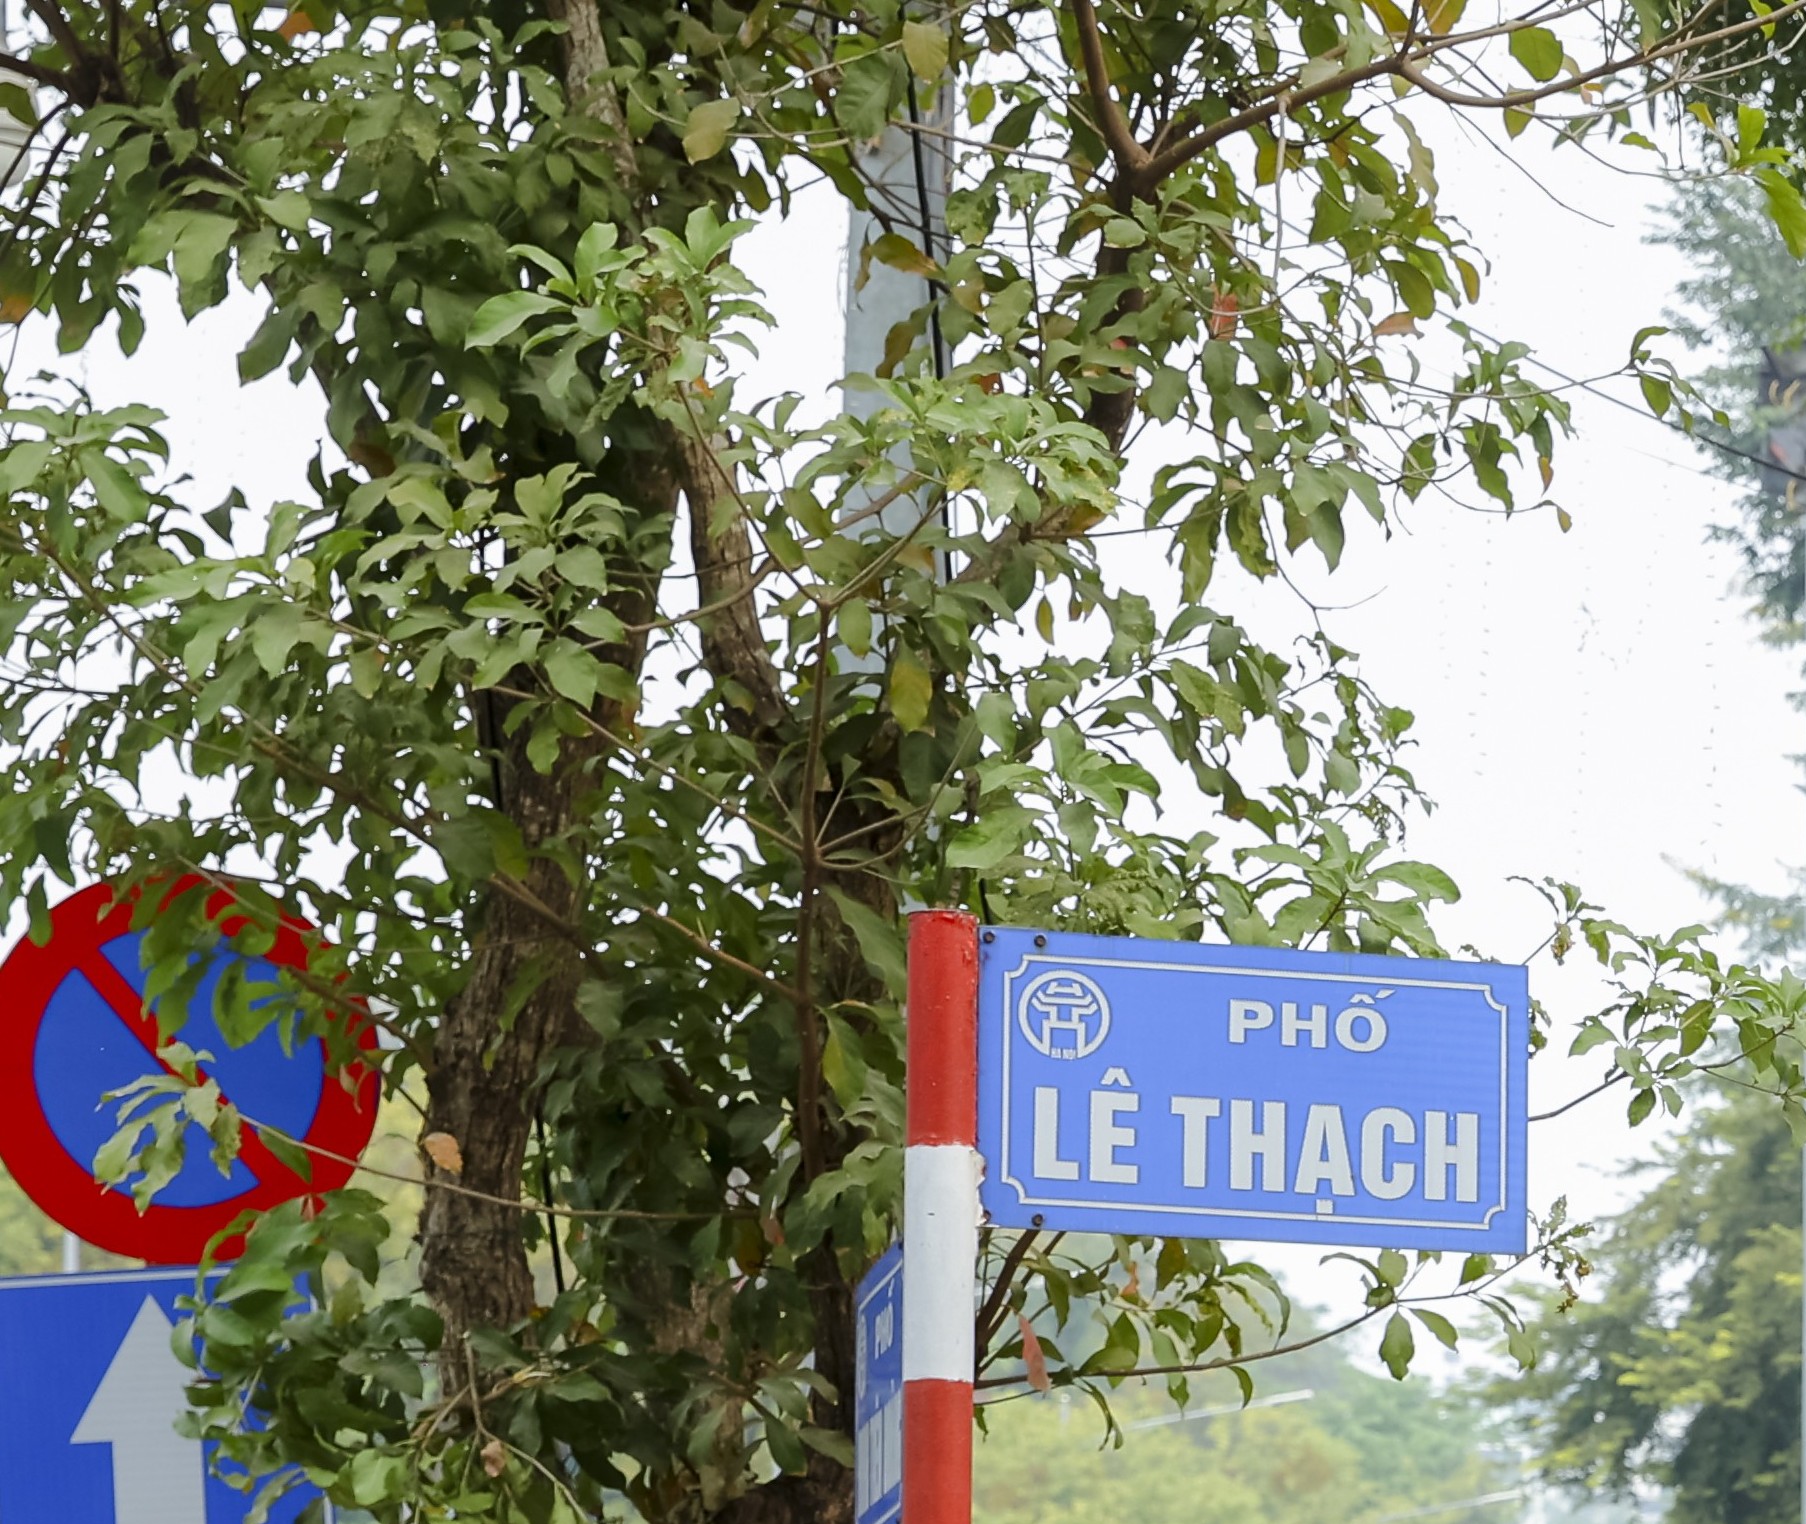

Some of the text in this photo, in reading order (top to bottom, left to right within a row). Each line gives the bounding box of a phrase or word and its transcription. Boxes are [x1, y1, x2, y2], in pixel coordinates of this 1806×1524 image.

[1229, 990, 1396, 1052] PHỐ
[1033, 1067, 1480, 1215] LÊ THẠCH
